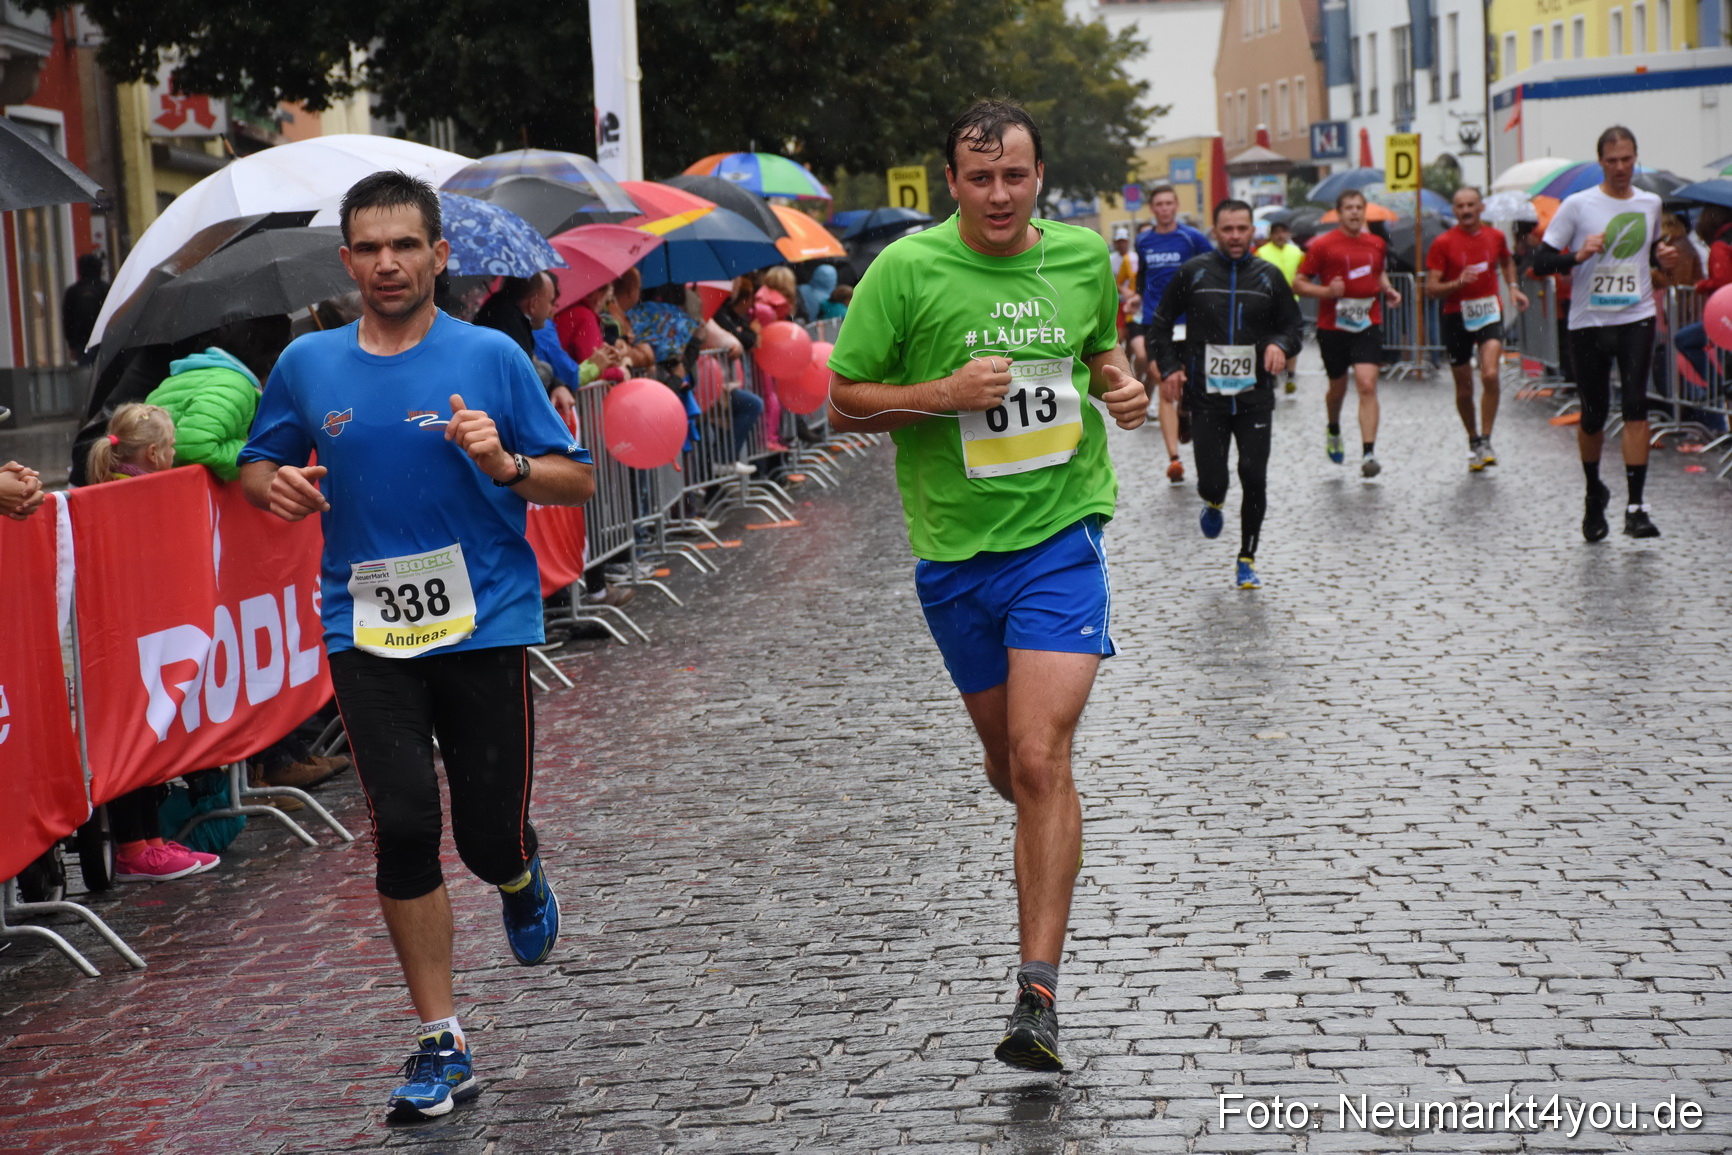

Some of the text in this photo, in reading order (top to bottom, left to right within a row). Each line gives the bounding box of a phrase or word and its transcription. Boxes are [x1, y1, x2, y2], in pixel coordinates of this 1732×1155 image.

[1396, 152, 1412, 179] D
[900, 185, 918, 209] D
[1594, 275, 1636, 293] 2715
[990, 301, 1040, 319] JONI
[984, 327, 1066, 346] LÄUFER
[1008, 362, 1063, 379] BOCK
[1210, 357, 1251, 376] 2629
[986, 386, 1057, 433] 613
[394, 551, 453, 574] BOCK
[355, 572, 390, 581] NeuerMarkt
[375, 578, 450, 623] 338
[385, 628, 447, 646] Andreas
